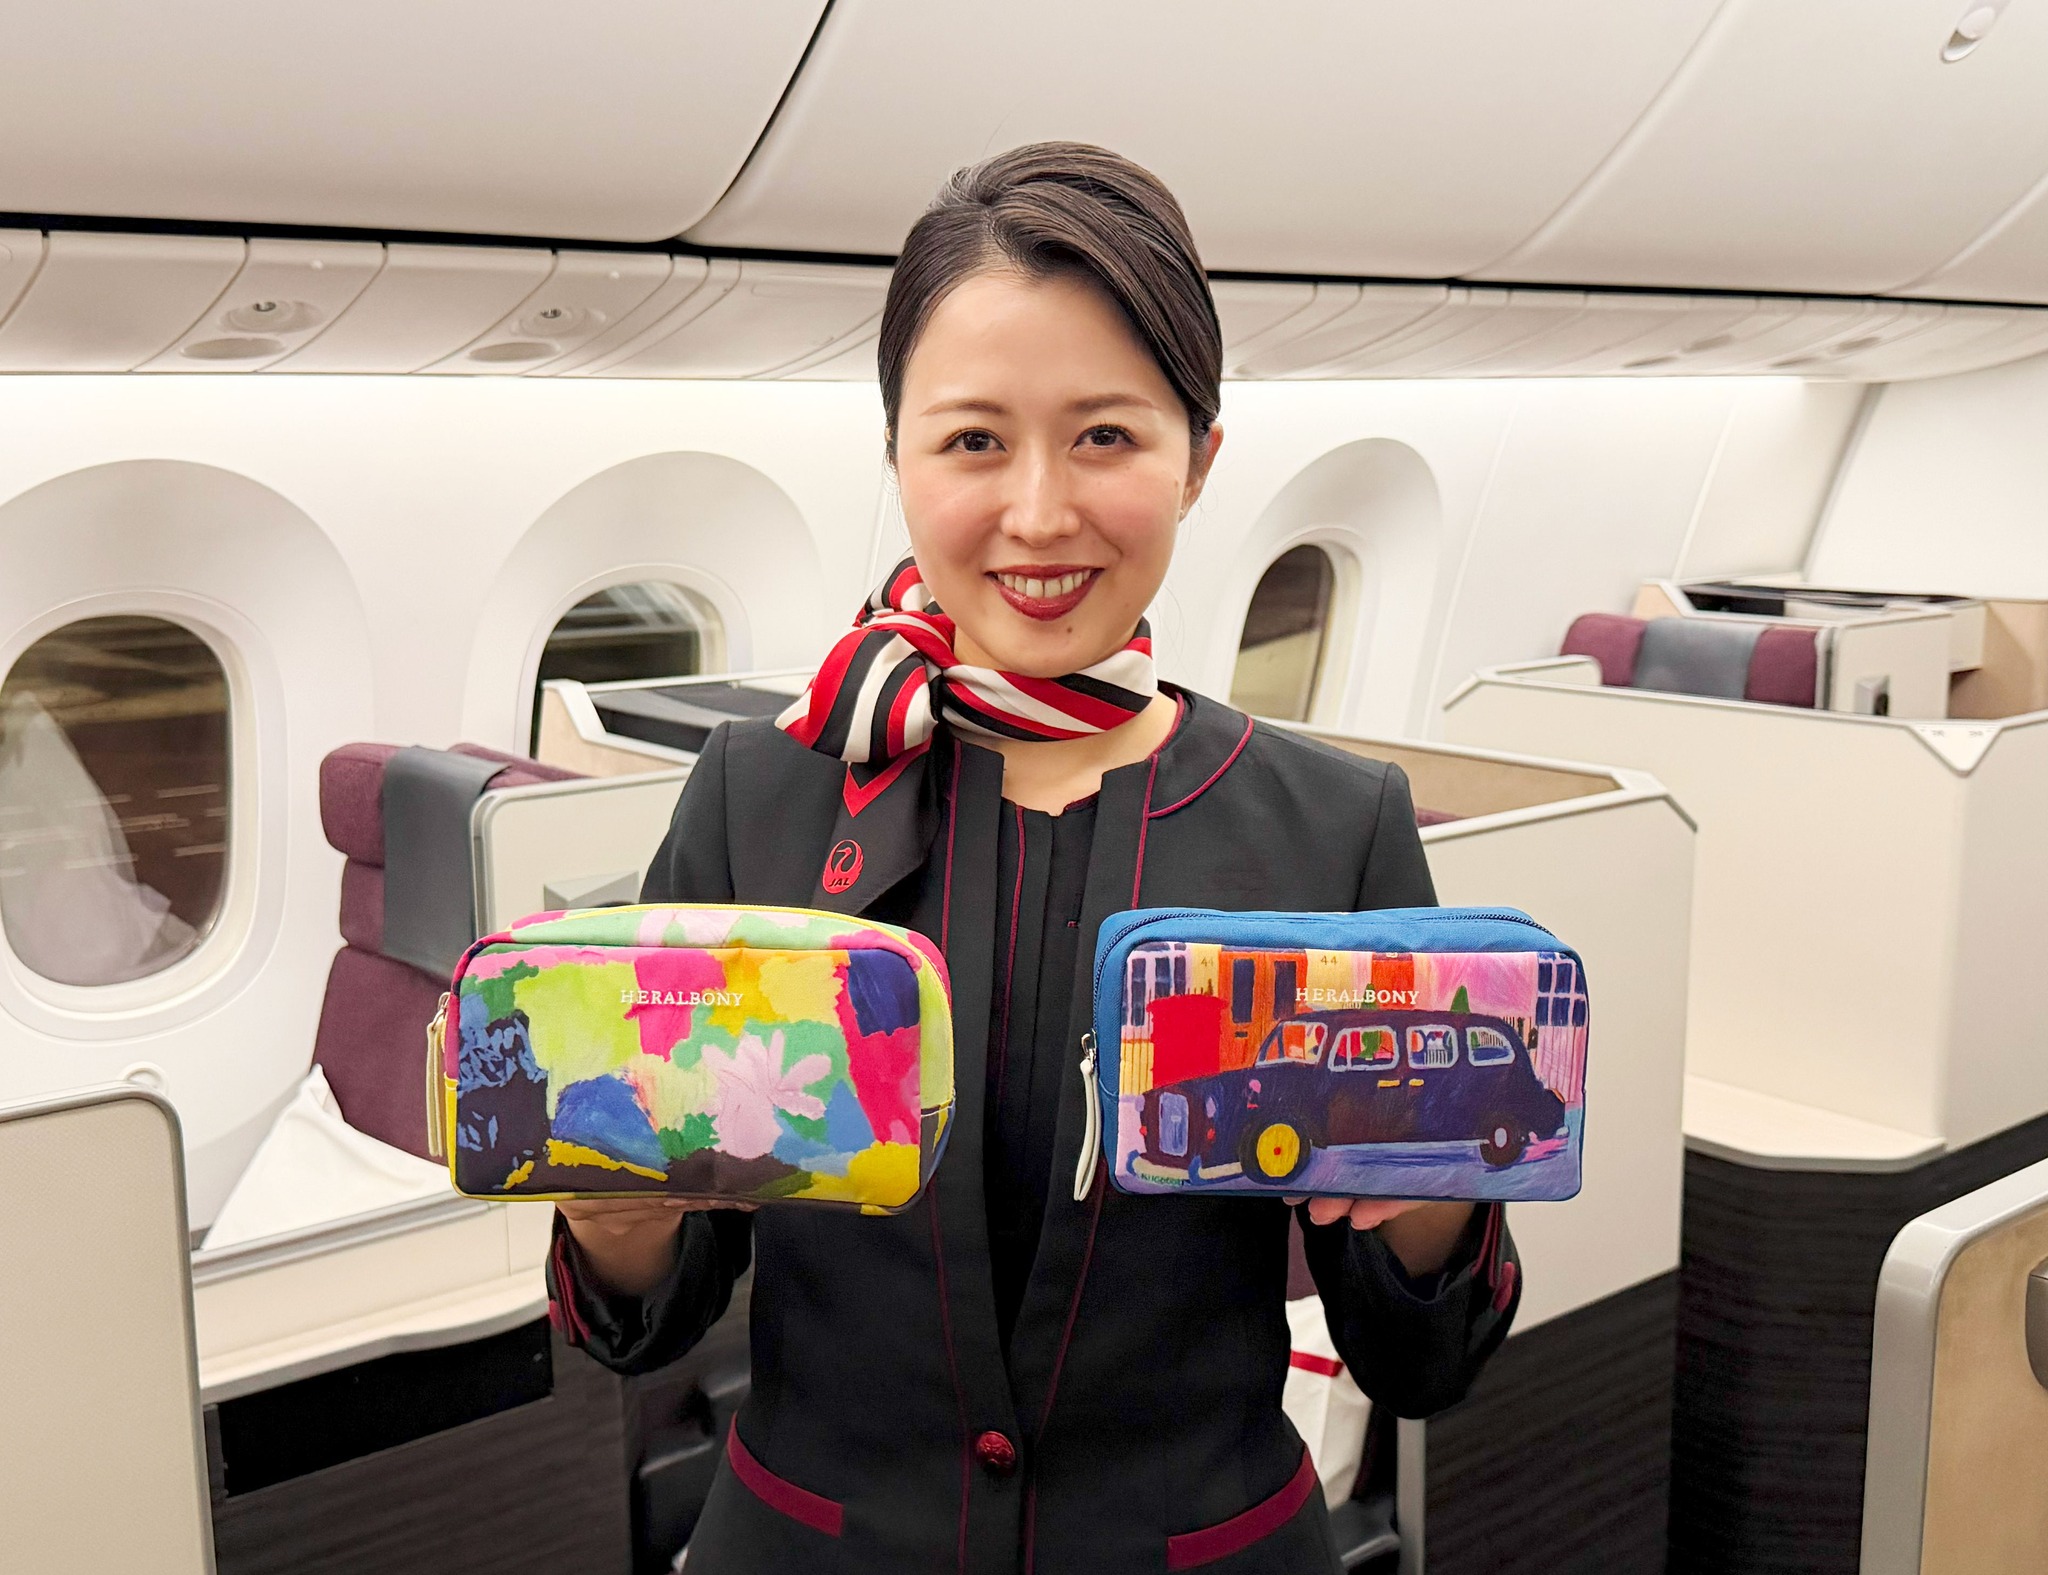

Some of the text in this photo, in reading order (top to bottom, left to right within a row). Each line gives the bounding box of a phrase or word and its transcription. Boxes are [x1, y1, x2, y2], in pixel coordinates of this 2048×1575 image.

[828, 878, 850, 887] JAL
[1320, 955, 1337, 966] 44
[620, 989, 743, 1007] HERALBONY
[1295, 987, 1419, 1005] HERALBONY
